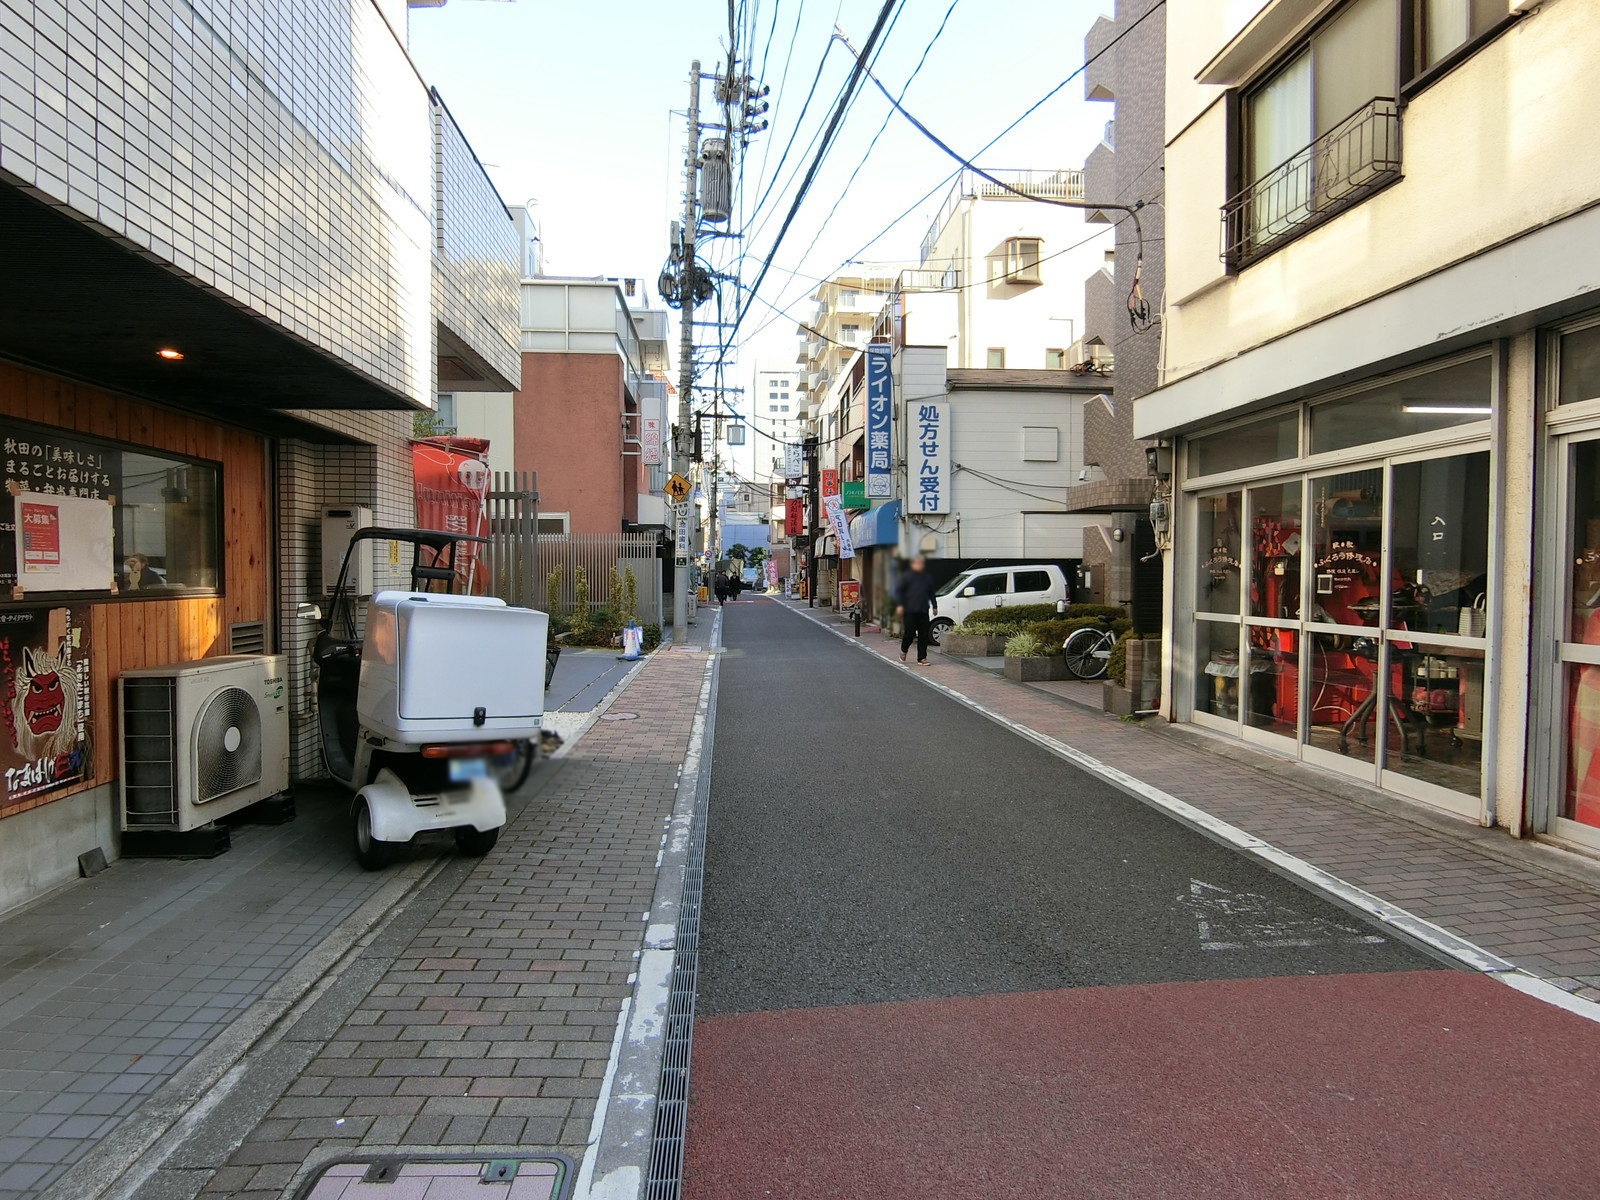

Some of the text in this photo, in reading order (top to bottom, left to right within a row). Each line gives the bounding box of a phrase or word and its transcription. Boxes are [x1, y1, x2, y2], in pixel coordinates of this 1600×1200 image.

[870, 357, 888, 470] ライオン薬局
[3, 437, 102, 470] 秋田の「美味しさ」
[792, 442, 801, 473] はらぺこ
[918, 405, 940, 511] 処方せん受付
[6, 459, 110, 487] まるごとお届けする
[24, 513, 50, 525] 大募集
[1431, 516, 1446, 541] 入口
[264, 677, 283, 686] TOSHIBA
